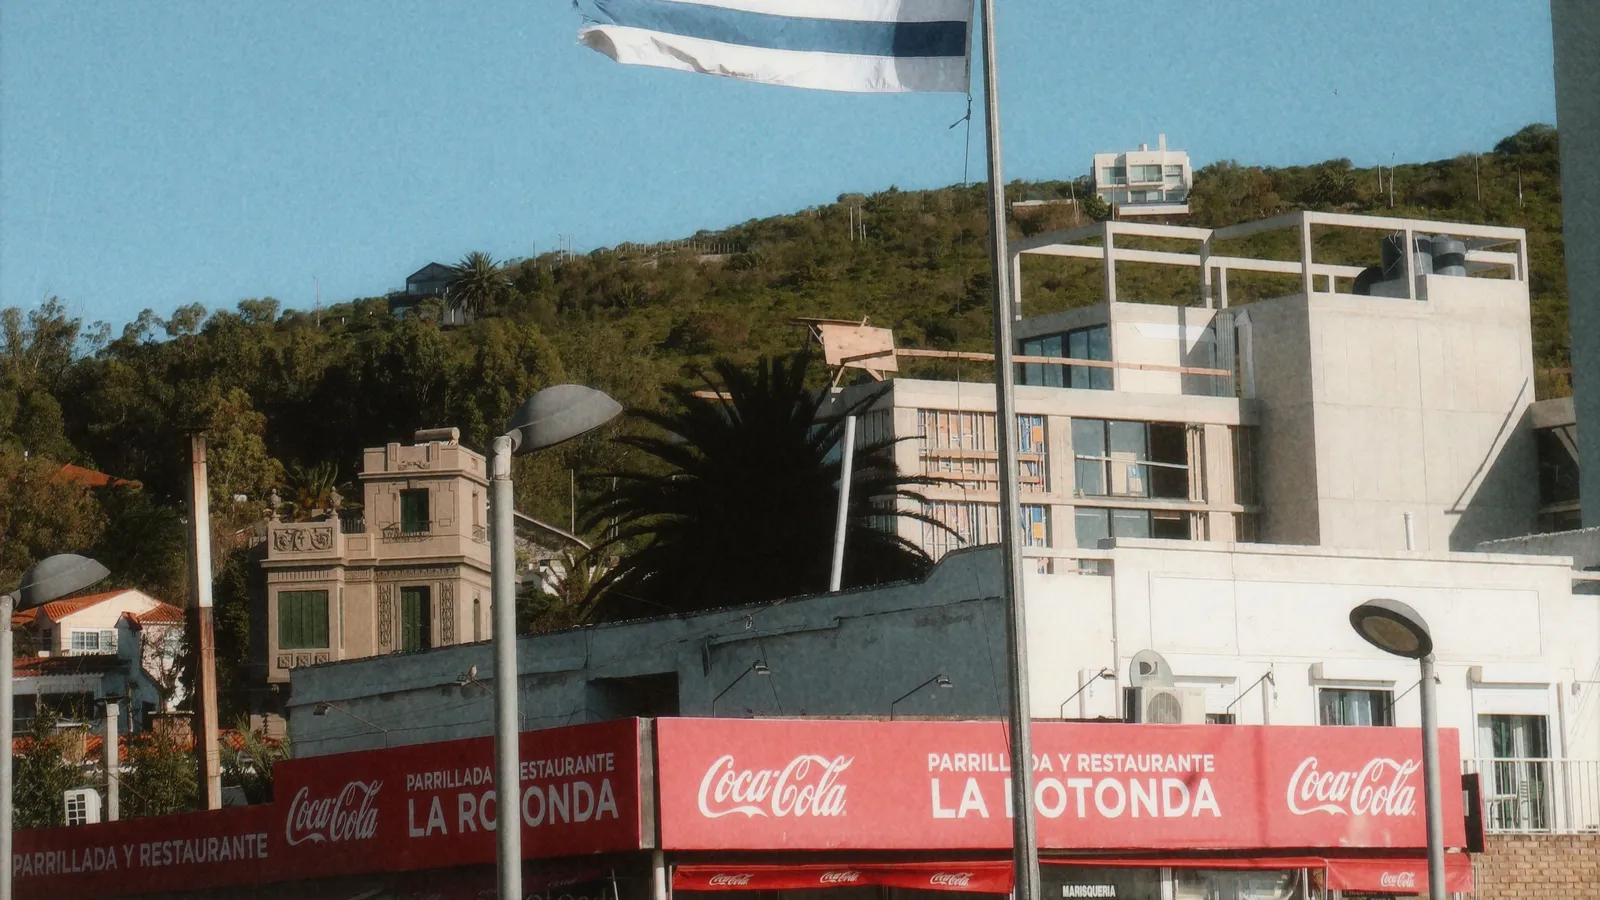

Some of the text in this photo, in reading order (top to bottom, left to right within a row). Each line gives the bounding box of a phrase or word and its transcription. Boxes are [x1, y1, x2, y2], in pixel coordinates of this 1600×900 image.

[406, 752, 615, 791] PARRILLADA ESTAURANTE
[928, 753, 1215, 772] PARRILLDA Y RESTAURANTE
[698, 754, 855, 819] Coca-Cola
[931, 778, 990, 819] LA
[1286, 756, 1421, 816] Coca-Cola
[286, 779, 384, 846] Coca-Cola
[408, 778, 619, 838] LA ROONDA
[12, 832, 268, 877] PARRILLADA Y RESTAURANTE
[709, 873, 755, 886] Coca-Cola
[820, 871, 859, 884] Coca-Cola
[930, 872, 975, 887] Coca-Cola
[1062, 884, 1116, 898] MARISQUERIA
[1380, 871, 1416, 888] Coca-Cola
